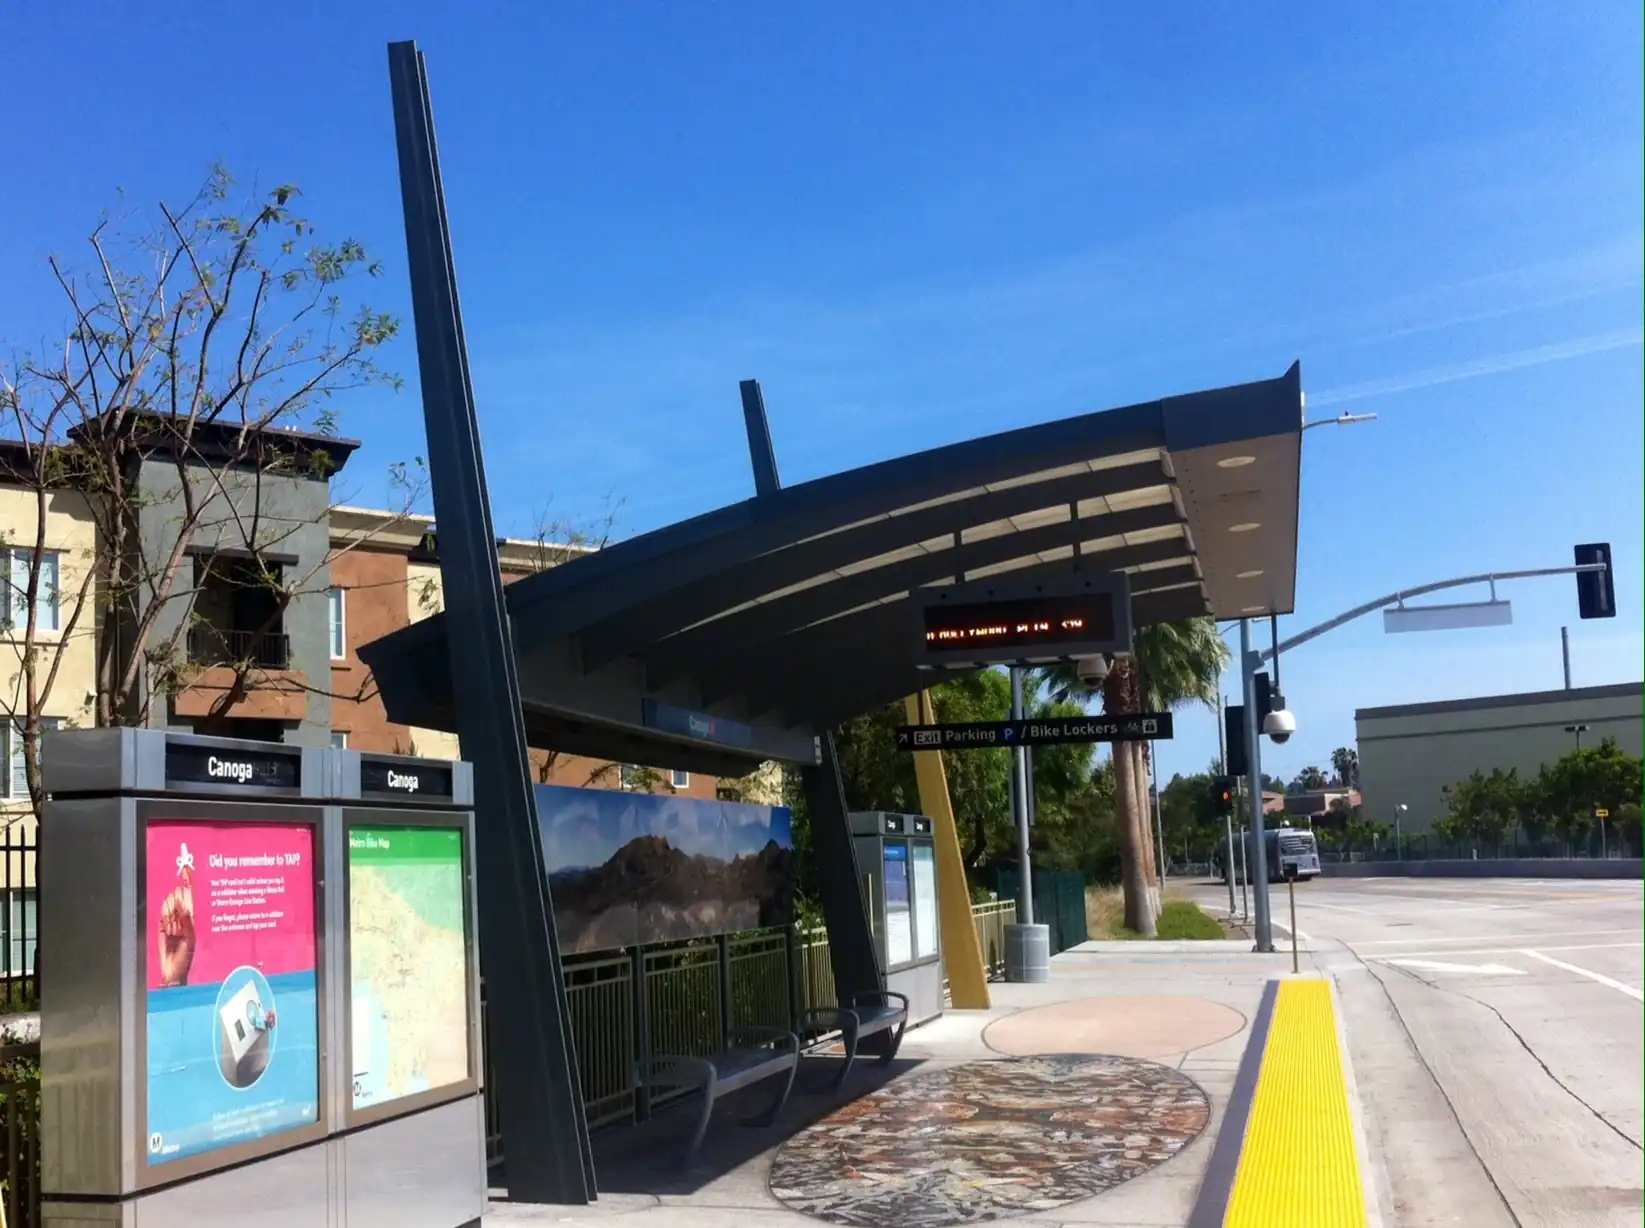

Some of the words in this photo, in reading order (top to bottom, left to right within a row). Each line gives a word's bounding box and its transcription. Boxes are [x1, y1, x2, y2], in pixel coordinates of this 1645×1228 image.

[915, 731, 940, 744] Exit
[945, 728, 996, 743] Parking
[1031, 725, 1060, 738] Bike
[1064, 723, 1118, 737] Lockers
[208, 756, 253, 783] Canoga
[387, 770, 419, 793] Canoga
[208, 853, 222, 868] Did
[223, 855, 238, 872] you
[238, 852, 275, 868] remember
[275, 854, 285, 867] to
[284, 851, 301, 867] TAP?
